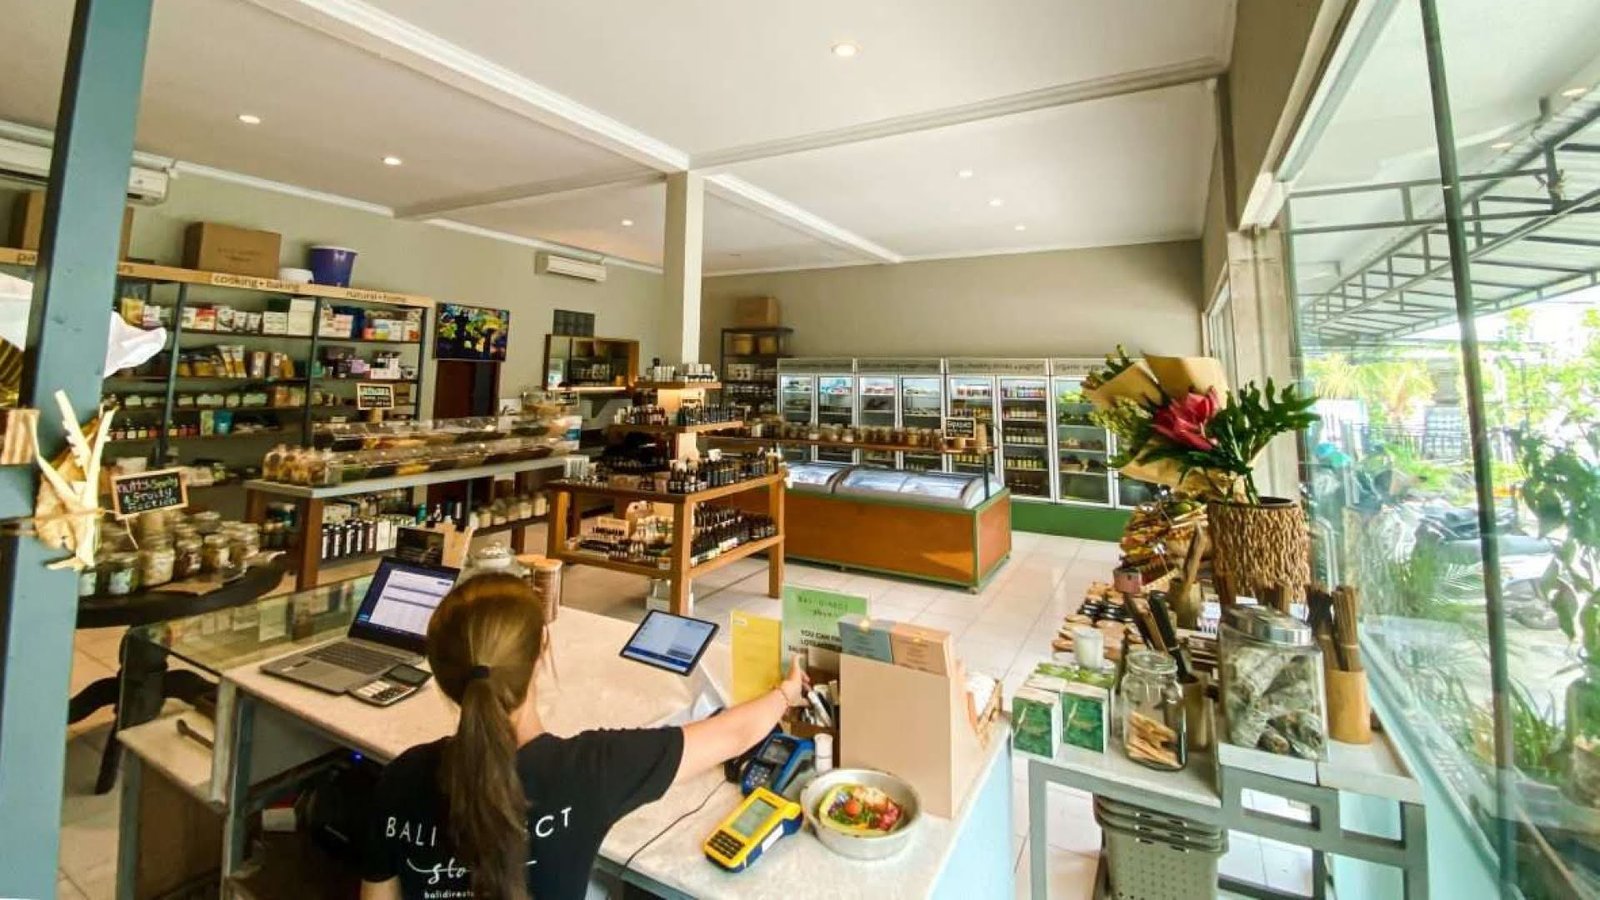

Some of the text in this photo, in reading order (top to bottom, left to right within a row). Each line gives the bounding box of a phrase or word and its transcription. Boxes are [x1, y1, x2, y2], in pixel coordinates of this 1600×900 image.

[213, 273, 258, 289] cooking
[266, 279, 301, 293] baking
[385, 815, 437, 848] BALI
